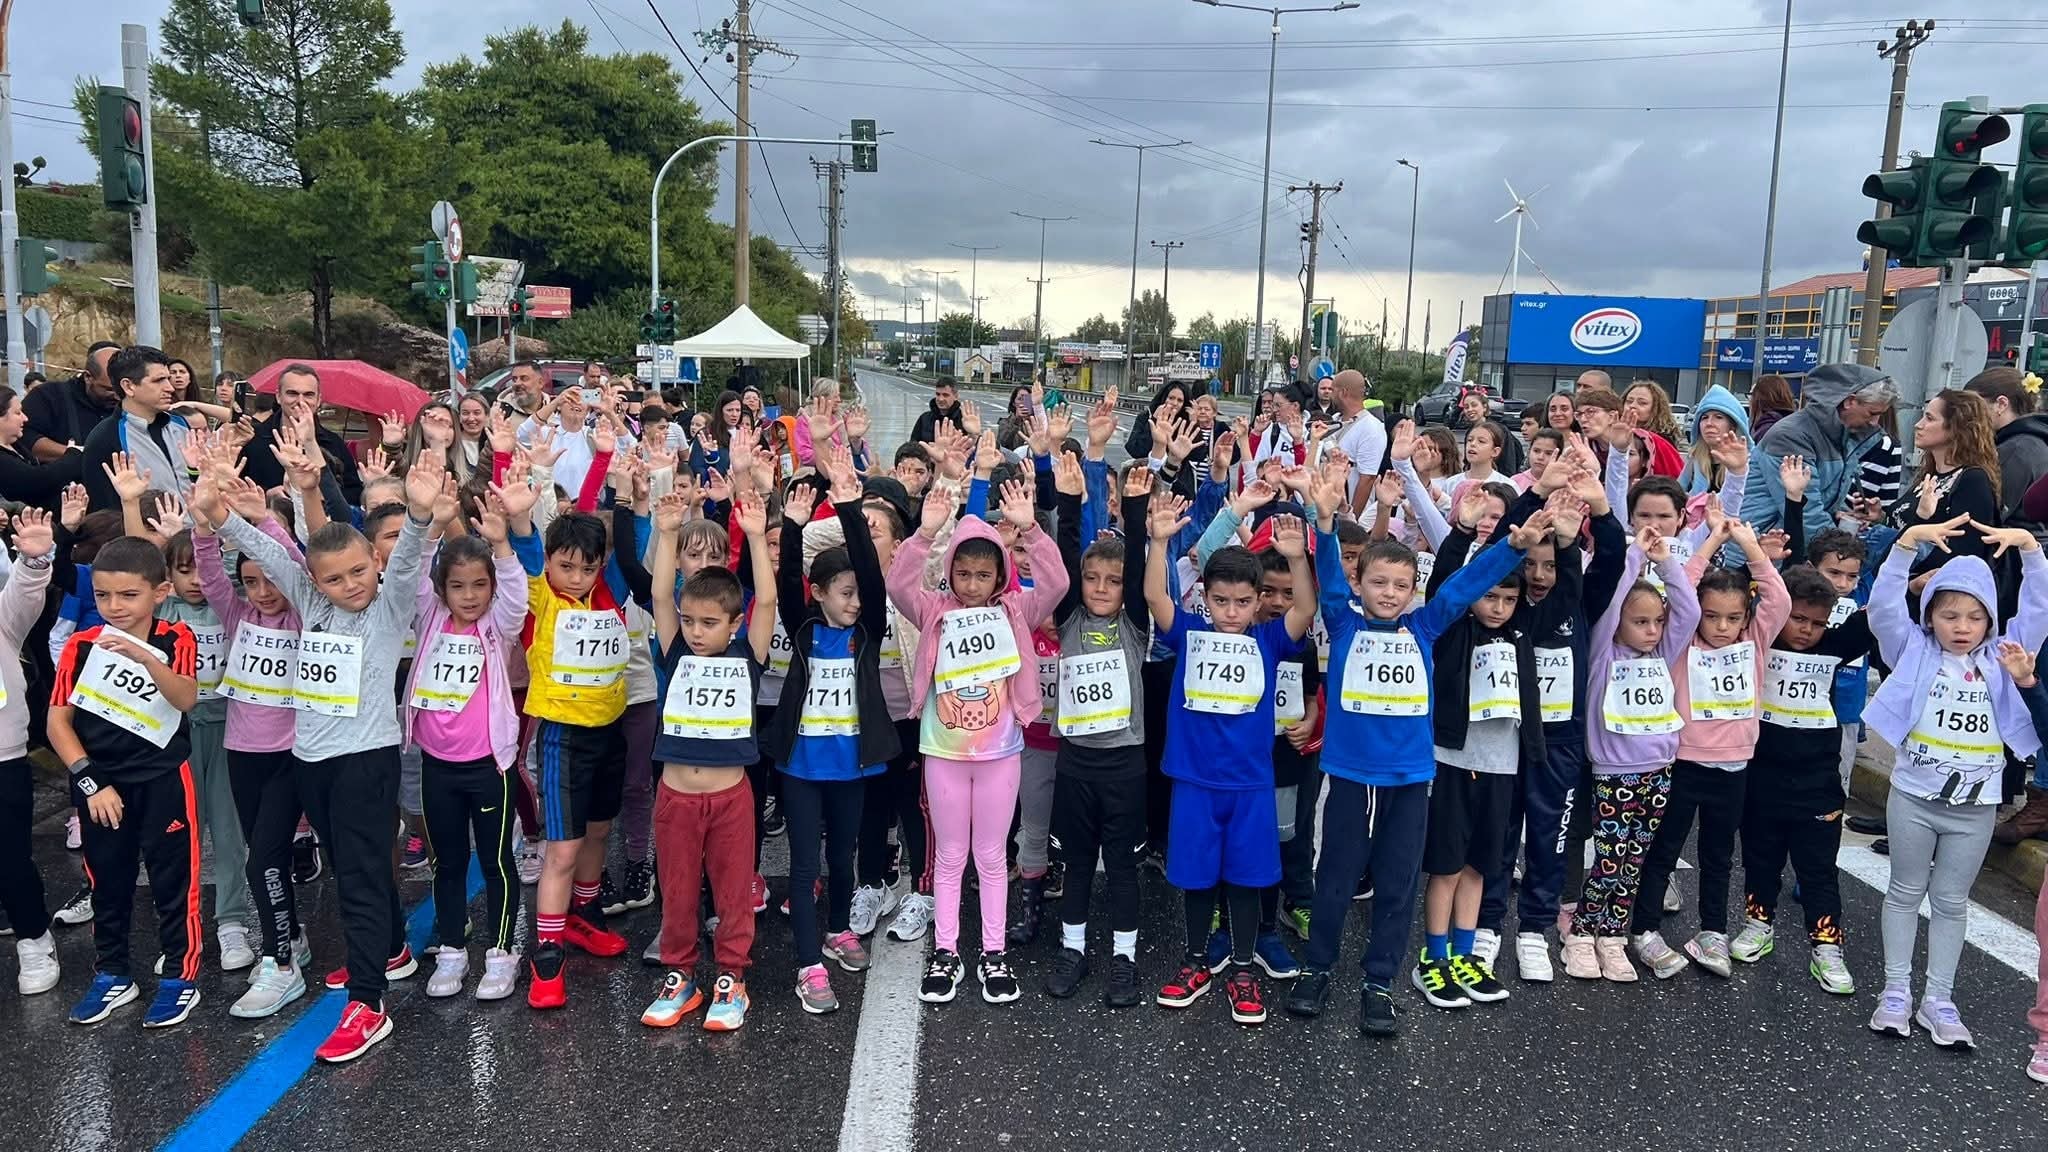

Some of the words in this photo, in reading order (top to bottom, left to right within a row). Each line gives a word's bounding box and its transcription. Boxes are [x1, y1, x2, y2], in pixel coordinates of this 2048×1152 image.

[1520, 301, 1547, 309] vitex.gr
[1584, 321, 1630, 337] vitex
[956, 612, 1001, 629] ΣΕΓΑΣ
[255, 635, 300, 650] ΣΕΓΑΣ
[303, 639, 355, 655] ΣΕΓΑΣ
[576, 637, 620, 657] 1716
[945, 632, 996, 659] 1490
[1212, 641, 1258, 656] ΣΕΓΑΣ
[241, 652, 287, 677] 1708
[433, 662, 480, 684] 1712
[702, 665, 747, 678] ΣΕΓΑΣ
[1076, 659, 1121, 675] ΣΕΓΑΣ
[1196, 661, 1246, 684] 1749
[1365, 663, 1415, 684] 1660
[1795, 661, 1832, 675] ΣΕΓΑΣ
[101, 663, 158, 702] 1592
[1777, 679, 1817, 699] 1579
[685, 687, 736, 708] 1575
[807, 688, 852, 707] 1711
[1070, 682, 1113, 704] 1688
[1621, 686, 1664, 706] 1668
[1935, 709, 1989, 733] 1588
[1556, 788, 1575, 854] GIVOVA
[264, 867, 286, 906] TREND
[274, 910, 291, 959] FOLLOW
